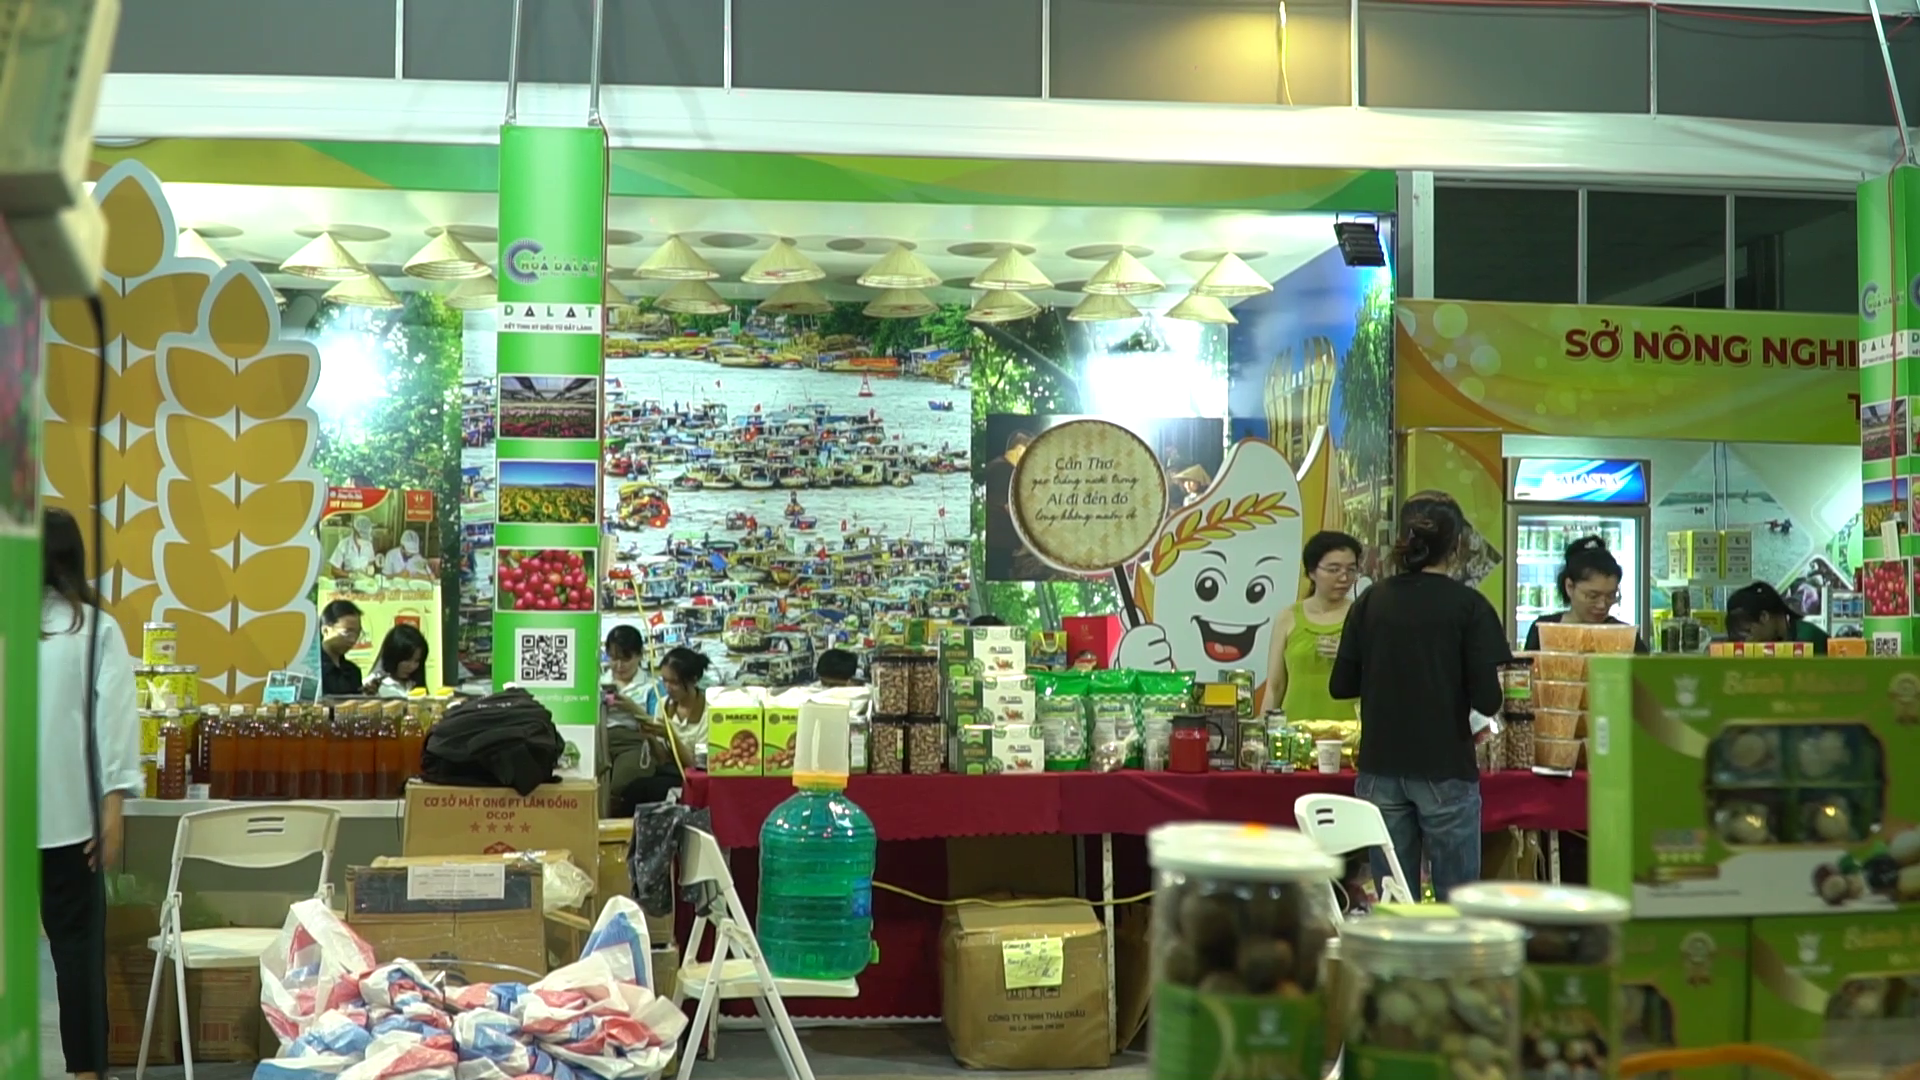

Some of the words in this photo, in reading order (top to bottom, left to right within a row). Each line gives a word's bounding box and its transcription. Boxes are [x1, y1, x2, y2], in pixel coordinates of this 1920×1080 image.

[503, 304, 595, 319] DALAT
[1564, 318, 1623, 361] SỞ
[1633, 325, 1750, 365] NÔNG
[1055, 456, 1082, 471] Cần
[1088, 456, 1115, 471] Thơ
[1047, 493, 1063, 506] Ai
[1066, 492, 1079, 506] đi
[1082, 490, 1107, 506] đến
[1111, 492, 1129, 506] đó
[482, 798, 506, 809] ONG
[987, 1013, 1010, 1023] CÔNG
